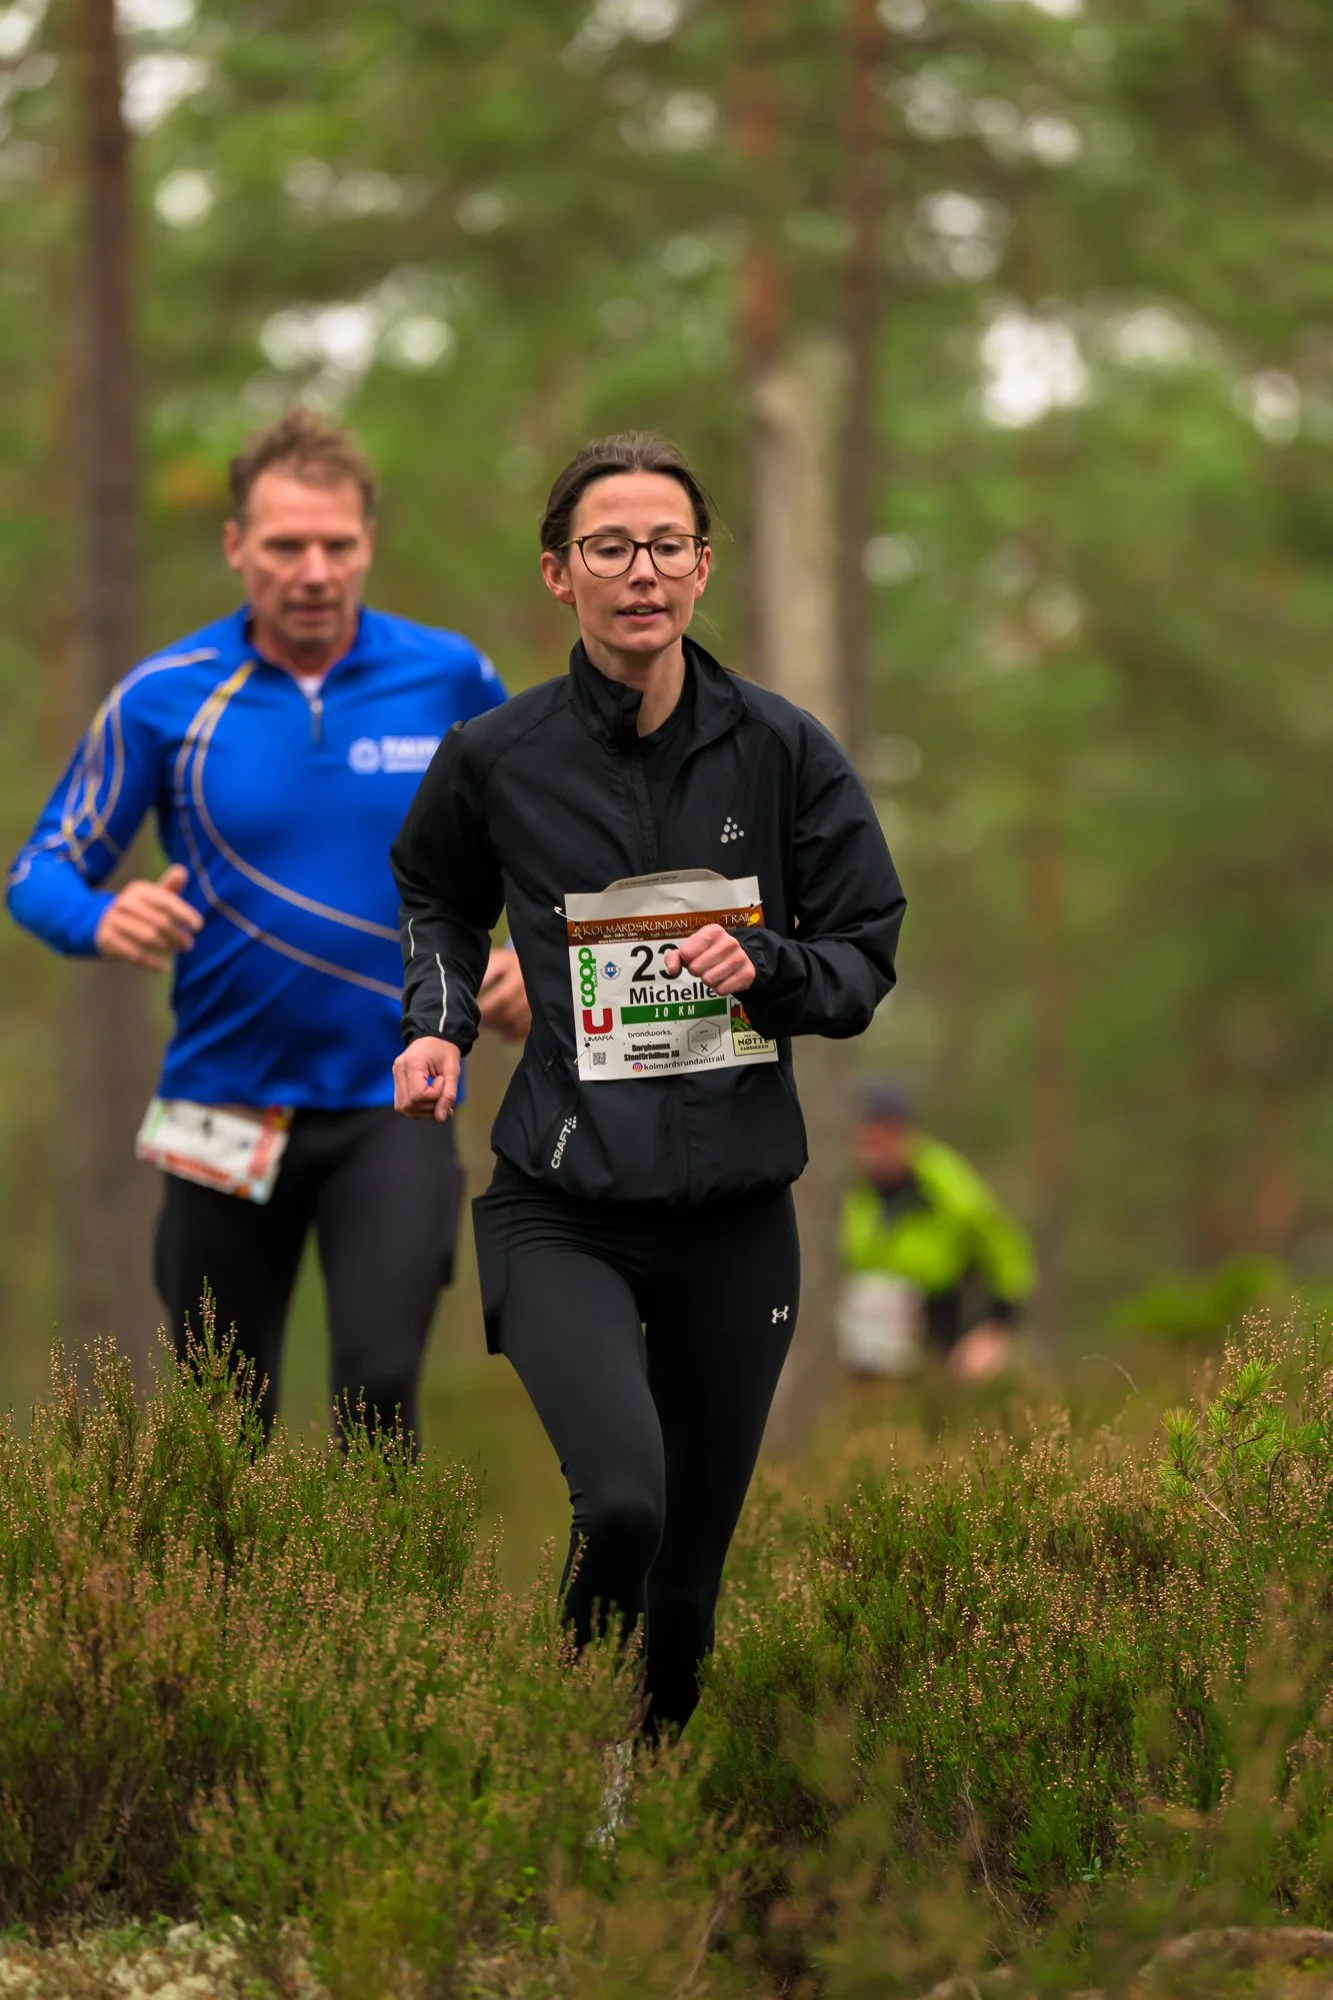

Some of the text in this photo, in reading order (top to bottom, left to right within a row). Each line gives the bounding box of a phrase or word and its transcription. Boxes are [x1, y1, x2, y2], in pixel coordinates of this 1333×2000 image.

[578, 947, 596, 1008] coop
[629, 981, 718, 1005] Michelle
[655, 1005, 695, 1018] 10 KM
[584, 1034, 614, 1042] UMARA
[643, 1054, 725, 1071] kolmardsrundantrail
[671, 1050, 680, 1058] AB
[551, 1124, 571, 1169] CRAFT
